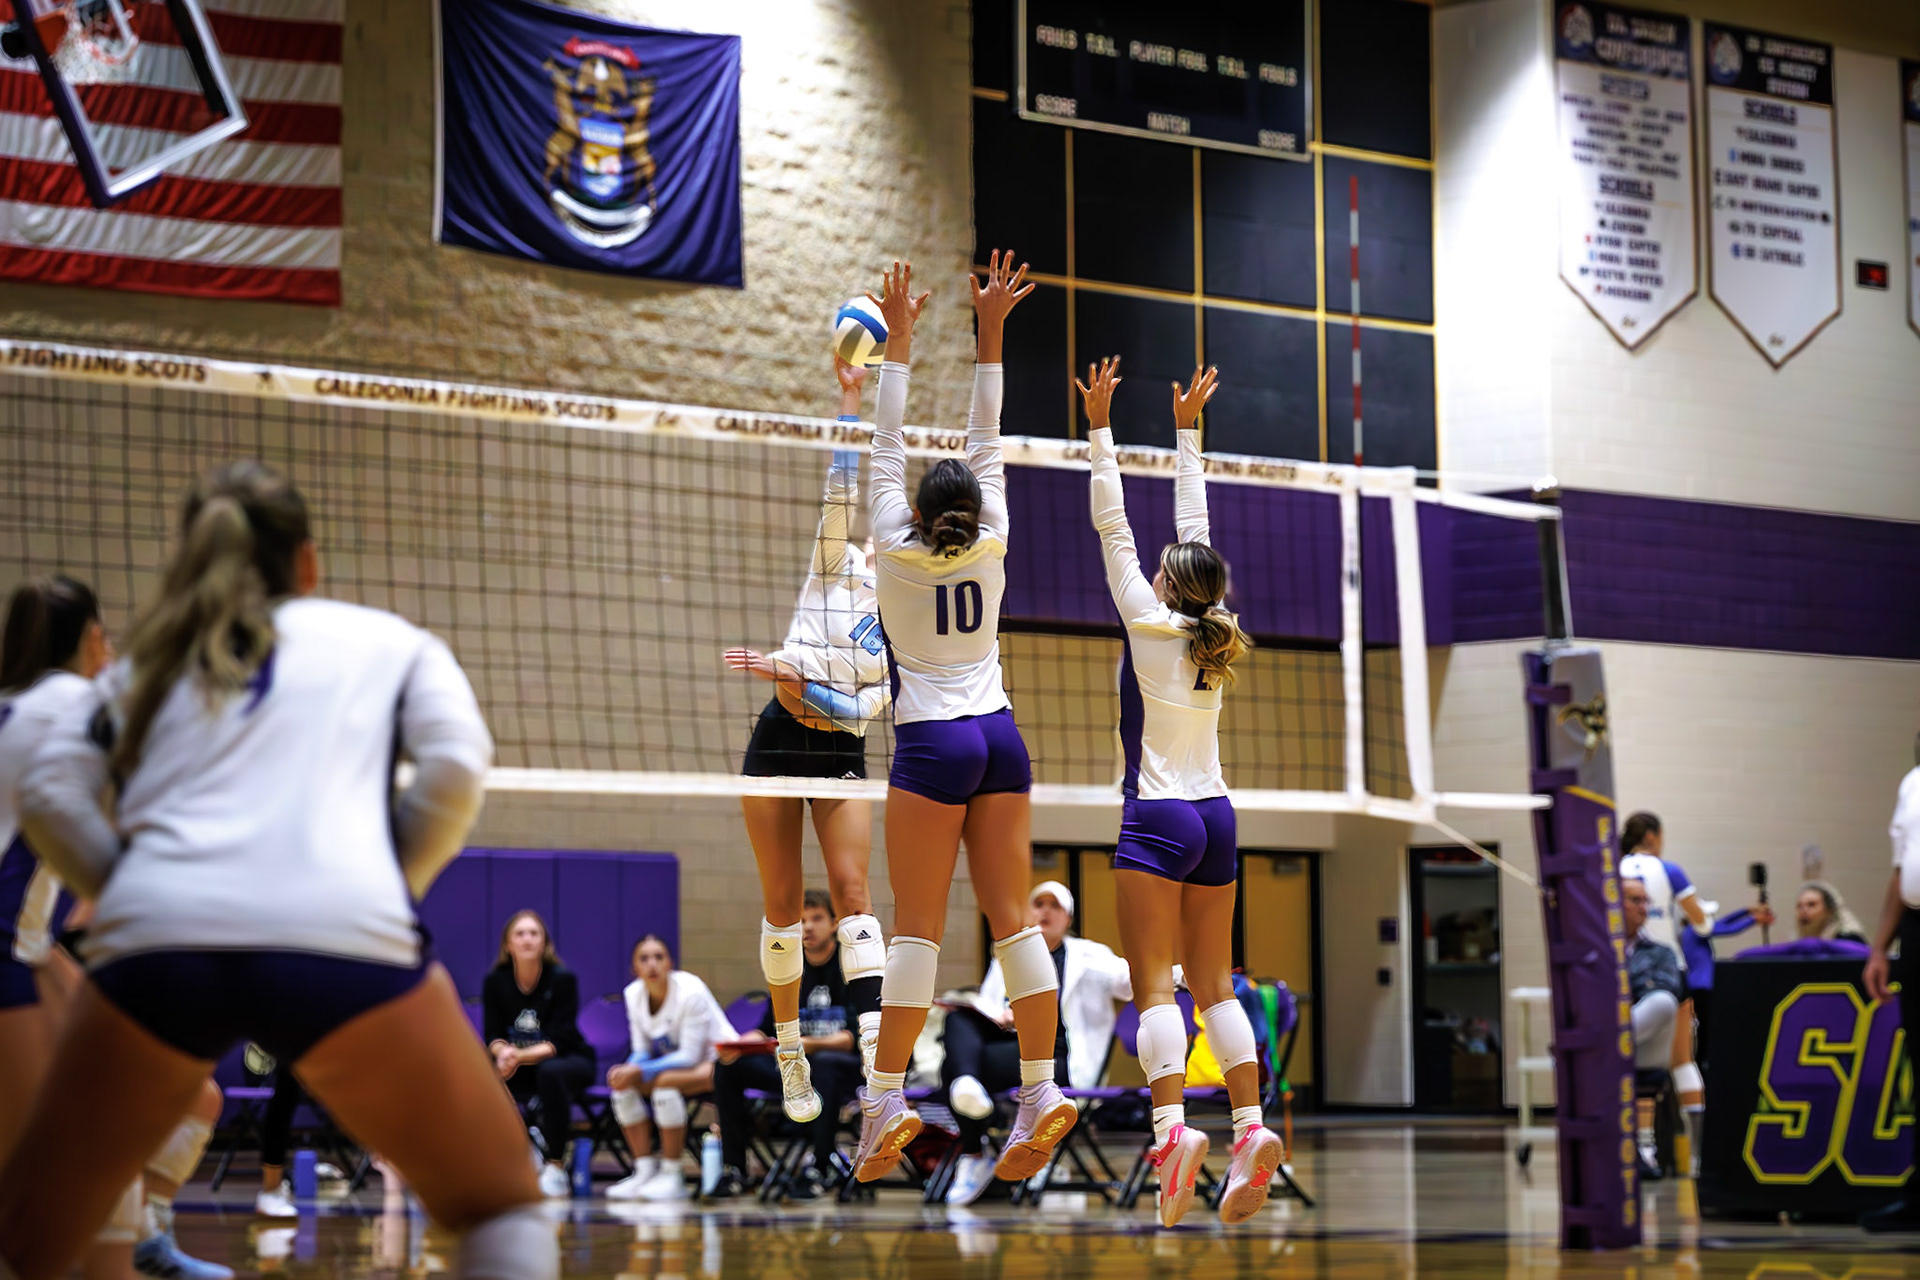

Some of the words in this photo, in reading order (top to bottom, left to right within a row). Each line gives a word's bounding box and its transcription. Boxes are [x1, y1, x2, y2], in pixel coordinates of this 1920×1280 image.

[1035, 94, 1077, 117] SCORE
[9, 347, 127, 375] FIGHTING
[134, 358, 206, 382] SCOTS
[314, 376, 438, 404] CALEDONIA
[449, 390, 549, 415] FIGHTING
[554, 399, 617, 421] SCOTS
[715, 415, 822, 441] CALEDONIA
[936, 580, 983, 635] 10
[1596, 816, 1634, 1058] FIGHTING
[1619, 1076, 1637, 1228] SCOTS
